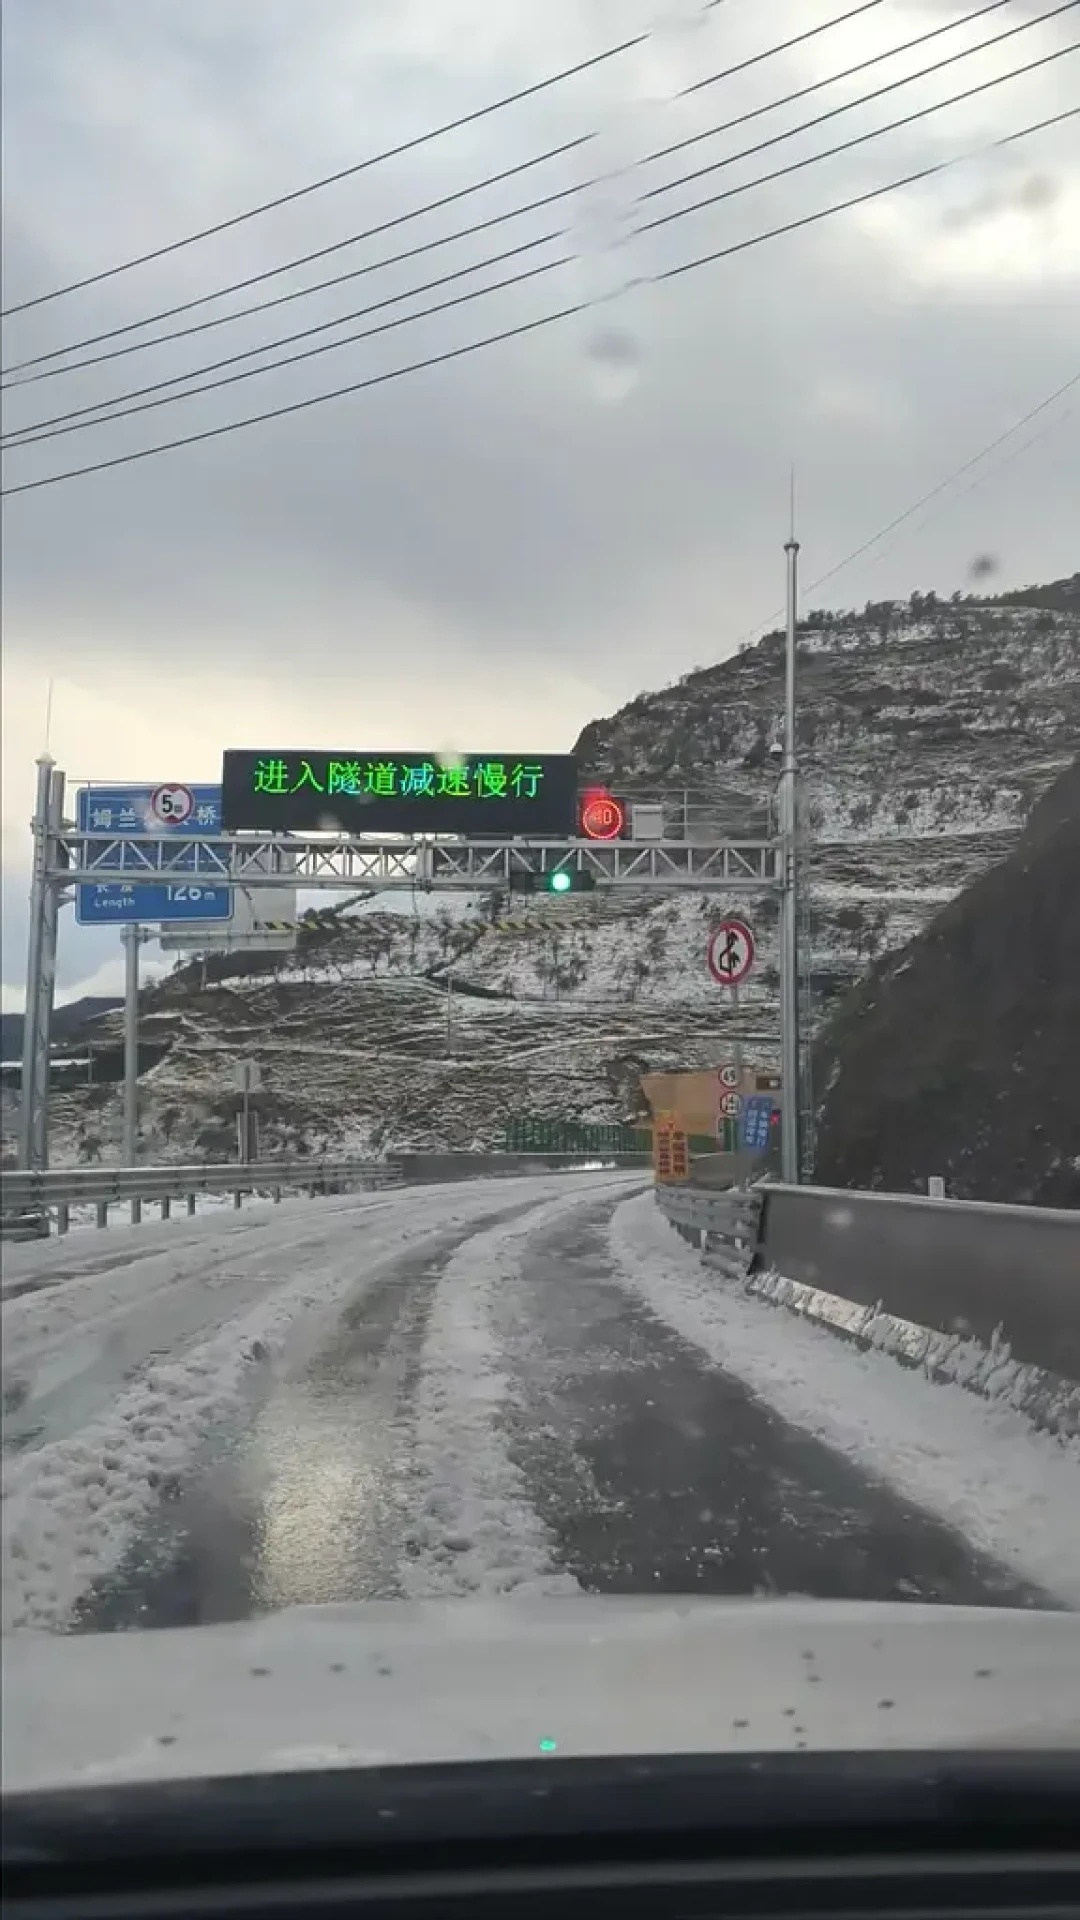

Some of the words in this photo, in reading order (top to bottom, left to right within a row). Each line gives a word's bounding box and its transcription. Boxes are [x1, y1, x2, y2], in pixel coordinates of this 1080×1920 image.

[253, 760, 544, 797] 进入隧道减速慢行
[94, 897, 135, 909] Length
